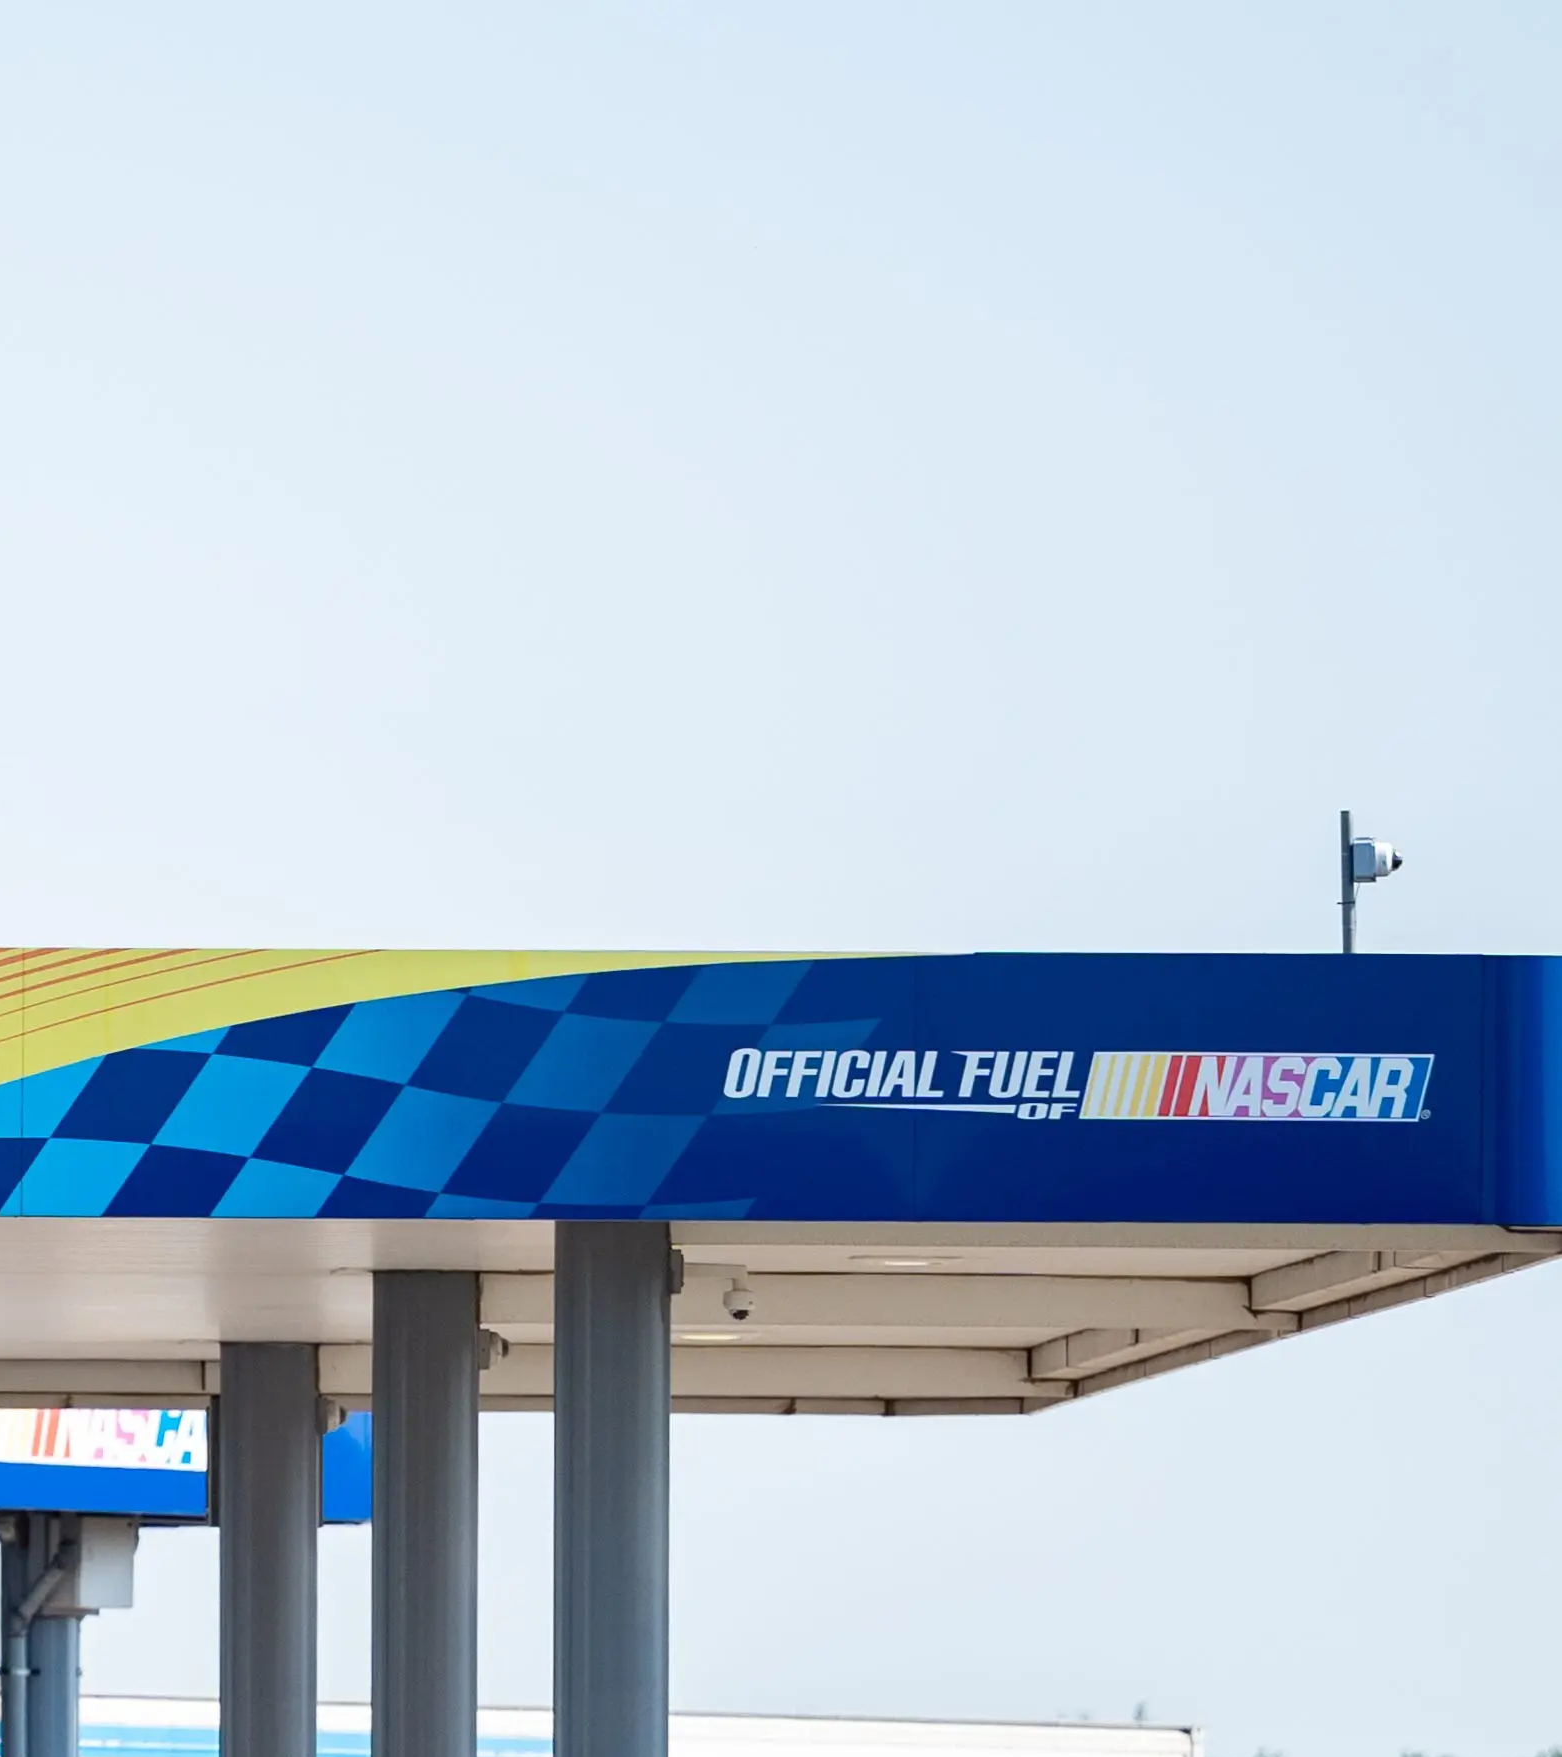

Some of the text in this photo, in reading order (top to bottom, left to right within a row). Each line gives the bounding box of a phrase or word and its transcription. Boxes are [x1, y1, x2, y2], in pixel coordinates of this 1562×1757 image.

[722, 1047, 1081, 1100] OFFICIAL FUEL
[1016, 1056, 1414, 1120] OF NASCAR
